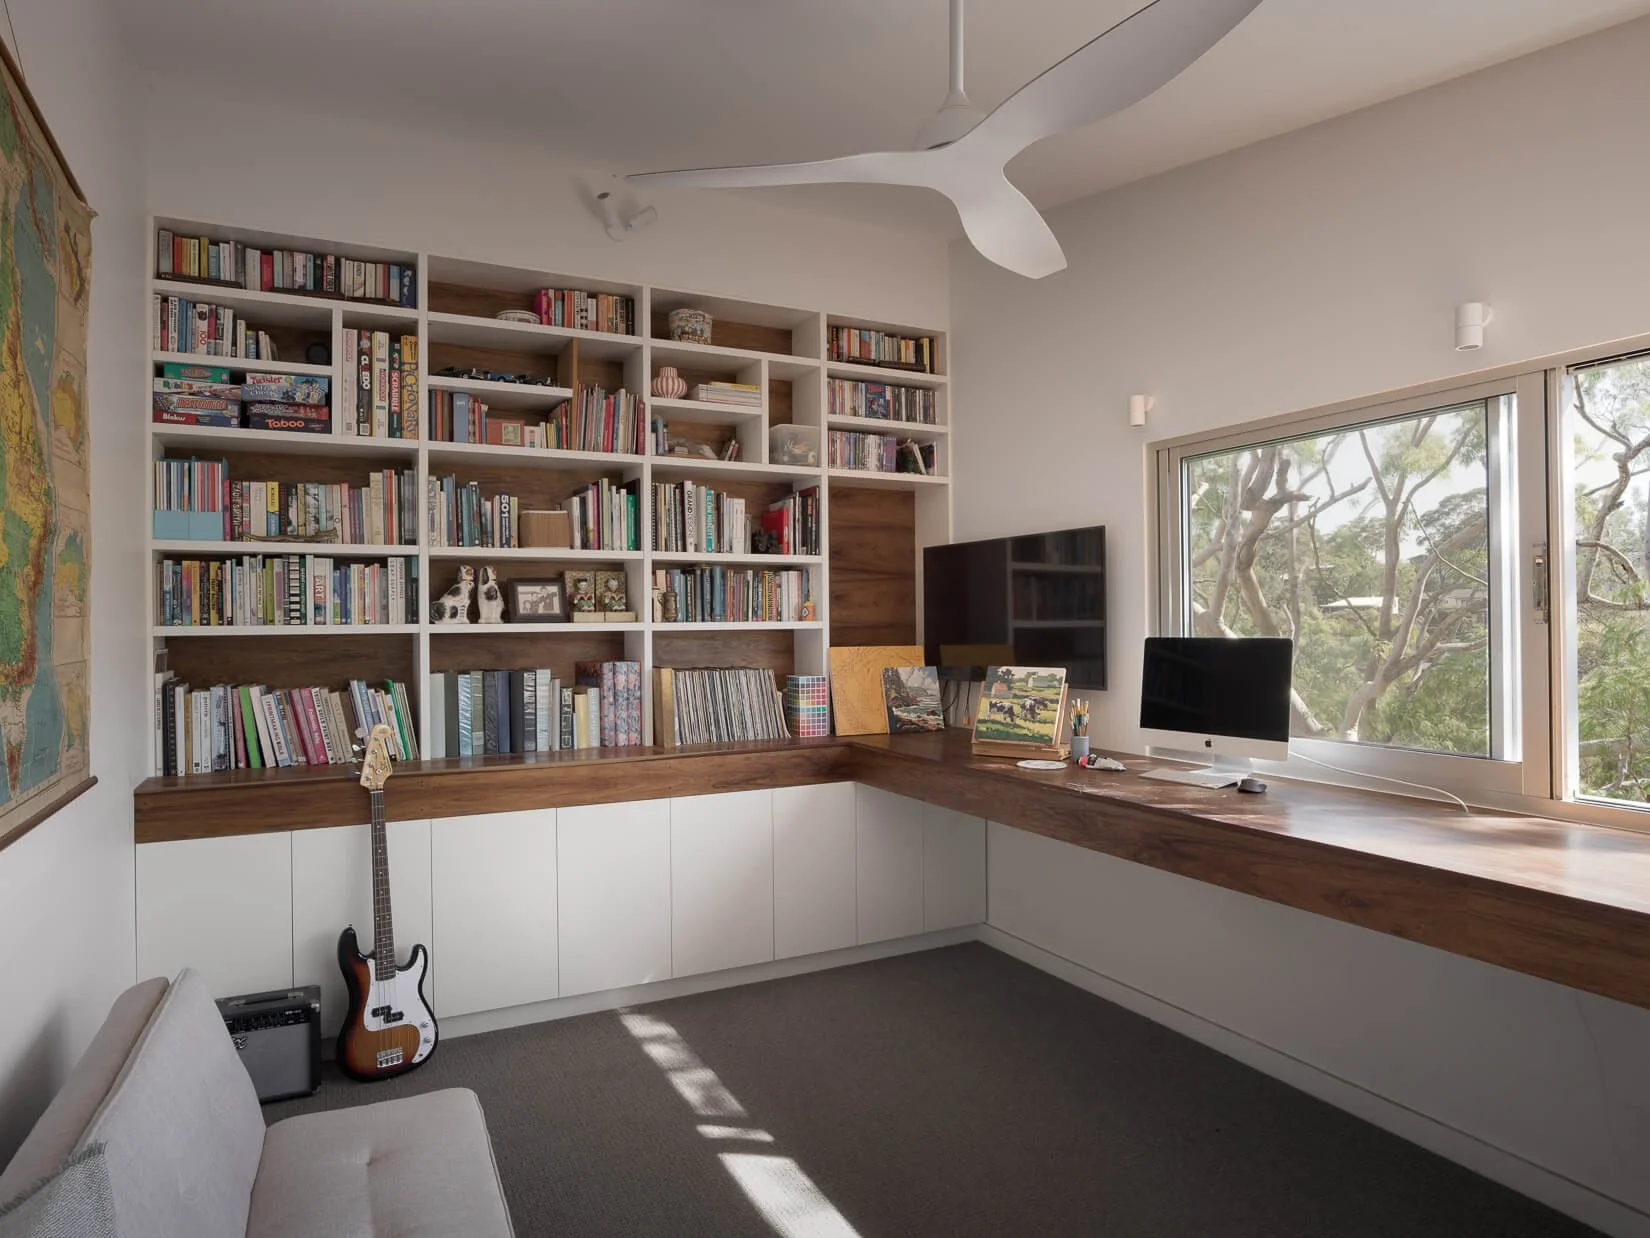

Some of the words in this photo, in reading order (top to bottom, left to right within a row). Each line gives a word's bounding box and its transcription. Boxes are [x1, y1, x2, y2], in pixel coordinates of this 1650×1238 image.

[391, 372, 400, 412] SCRABBLE
[266, 418, 305, 428] Taboo
[501, 495, 510, 517] 501
